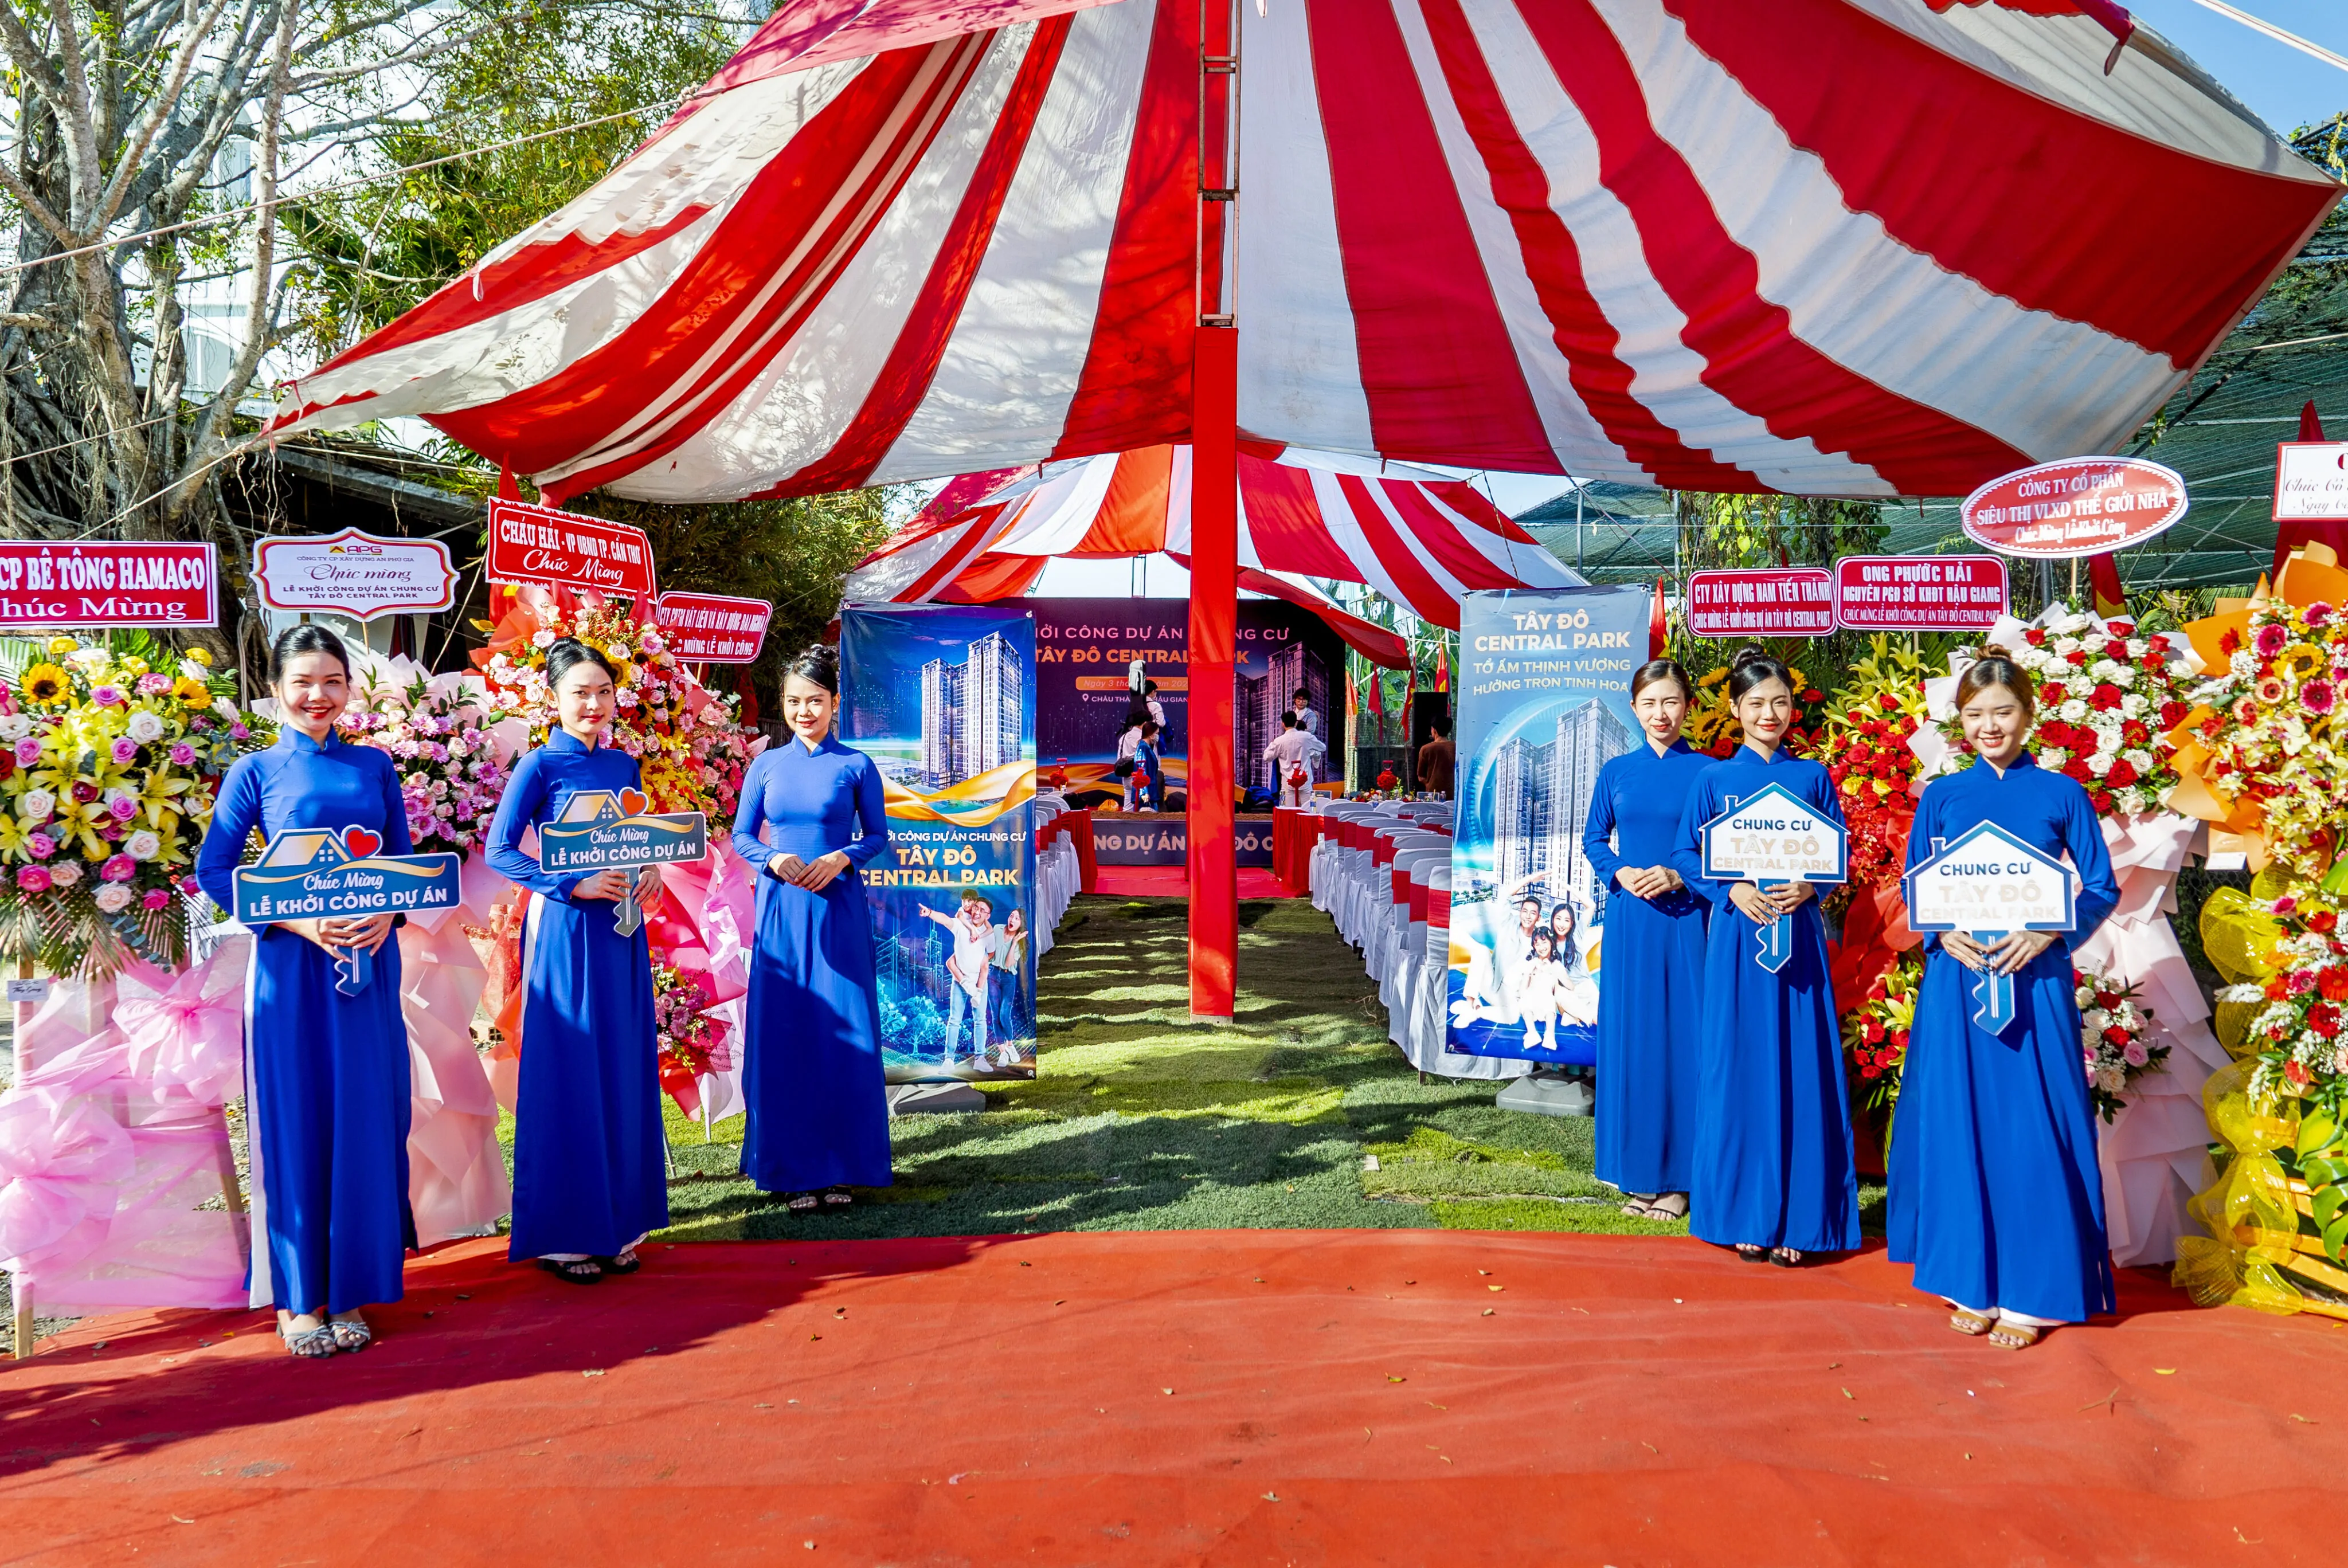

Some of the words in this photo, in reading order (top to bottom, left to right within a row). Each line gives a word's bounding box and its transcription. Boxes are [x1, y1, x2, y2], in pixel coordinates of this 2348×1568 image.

[2018, 479, 2051, 497] CÔNG
[2053, 478, 2069, 493] TY
[2071, 469, 2088, 492] CỔ
[2091, 465, 2125, 489] PHẦN
[1977, 504, 2006, 526] SIÊU
[2009, 505, 2032, 524] THỊ
[2035, 501, 2071, 520] VLXD
[2073, 492, 2102, 516] THẾ
[2105, 492, 2134, 512] GIỚI
[2137, 487, 2169, 510] NHÀ
[500, 516, 535, 547] CHÁU
[538, 519, 561, 551] HẢI
[565, 532, 576, 552] VP
[577, 535, 598, 558] UBND
[611, 534, 627, 562] CẦN
[626, 545, 641, 565] THƠ
[26, 547, 54, 590] BÊ
[57, 547, 115, 590] TÔNG
[118, 557, 205, 590] HAMACO
[304, 564, 360, 582] Chúc
[364, 569, 412, 582] mừng
[523, 549, 569, 571] Chúc
[572, 558, 624, 587] Mừng
[1862, 566, 1890, 582] ONG
[1945, 561, 1972, 582] HẢI
[1695, 584, 1710, 603] CTY
[1712, 580, 1729, 603] XÂY
[1732, 581, 1754, 606] DỰNG
[1756, 583, 1776, 602] NAM
[1778, 577, 1799, 602] TIẾN
[1801, 578, 1831, 601] THÀNH
[1843, 583, 1880, 602] NGUYÊN
[1903, 582, 1916, 602] SỞ
[1947, 584, 1967, 606] HẬU
[1970, 586, 2001, 602] GIANG
[0, 597, 67, 617] húc
[78, 597, 187, 620] Mừng
[1513, 610, 1552, 631] TÂY
[1556, 608, 1589, 629] ĐÔ
[1065, 625, 1119, 638] CÔNG
[1126, 625, 1152, 641] DỰ
[1157, 625, 1183, 638] ÁN
[1263, 627, 1289, 640] CƯ
[1474, 634, 1567, 652] CENTRAL
[1574, 632, 1631, 649] PARK
[683, 636, 706, 654] MỪNG
[706, 635, 716, 654] LỄ
[717, 636, 734, 655] KHỞI
[734, 640, 754, 655] CÔNG
[1036, 645, 1067, 663] TÂY
[1071, 645, 1101, 663] ĐÔ
[1497, 658, 1519, 673] ẤM
[1523, 661, 1571, 675] THỊNH
[1574, 658, 1631, 673] VƯỢNG
[1524, 677, 1560, 689] TRỌN
[1564, 677, 1596, 688] TINH
[1599, 679, 1629, 692] HOA
[1091, 694, 1114, 702] CHÂU
[1732, 819, 1786, 830] CHUNG
[1790, 820, 1812, 831] CƯ
[590, 829, 617, 844] Chúc
[619, 828, 649, 843] Mừng
[898, 830, 930, 841] CÔNG
[933, 830, 949, 843] DỰ
[950, 830, 967, 841] ÁN
[968, 833, 1008, 841] CHUNG
[1010, 830, 1027, 841] CƯ
[1126, 833, 1155, 855] DỰ
[1157, 830, 1185, 850] ÁN
[1731, 834, 1776, 854] TÂY
[1782, 836, 1819, 856] ĐÔ
[551, 848, 566, 867] LỄ
[570, 846, 605, 864] KHỞI
[609, 845, 651, 861] CÔNG
[655, 843, 675, 860] DỰ
[677, 840, 696, 856] ÁN
[896, 844, 938, 865] TÂY
[942, 845, 977, 865] ĐÔ
[1713, 857, 1785, 869] CENTRAL
[1790, 859, 1833, 871] PARK
[859, 869, 955, 886] CENTRAL
[961, 869, 1019, 885] PARK
[1940, 863, 2001, 876] CHUNG
[2007, 861, 2032, 875] CƯ
[303, 873, 341, 891] Chúc
[343, 872, 384, 890] Mừng
[1938, 881, 1990, 903] TÂY
[1998, 879, 2042, 903] ĐÔ
[250, 895, 272, 917] LỄ
[276, 893, 324, 914] KHỞI
[329, 891, 387, 910] CÔNG
[392, 889, 418, 909] DỰ
[422, 886, 447, 903] ÁN
